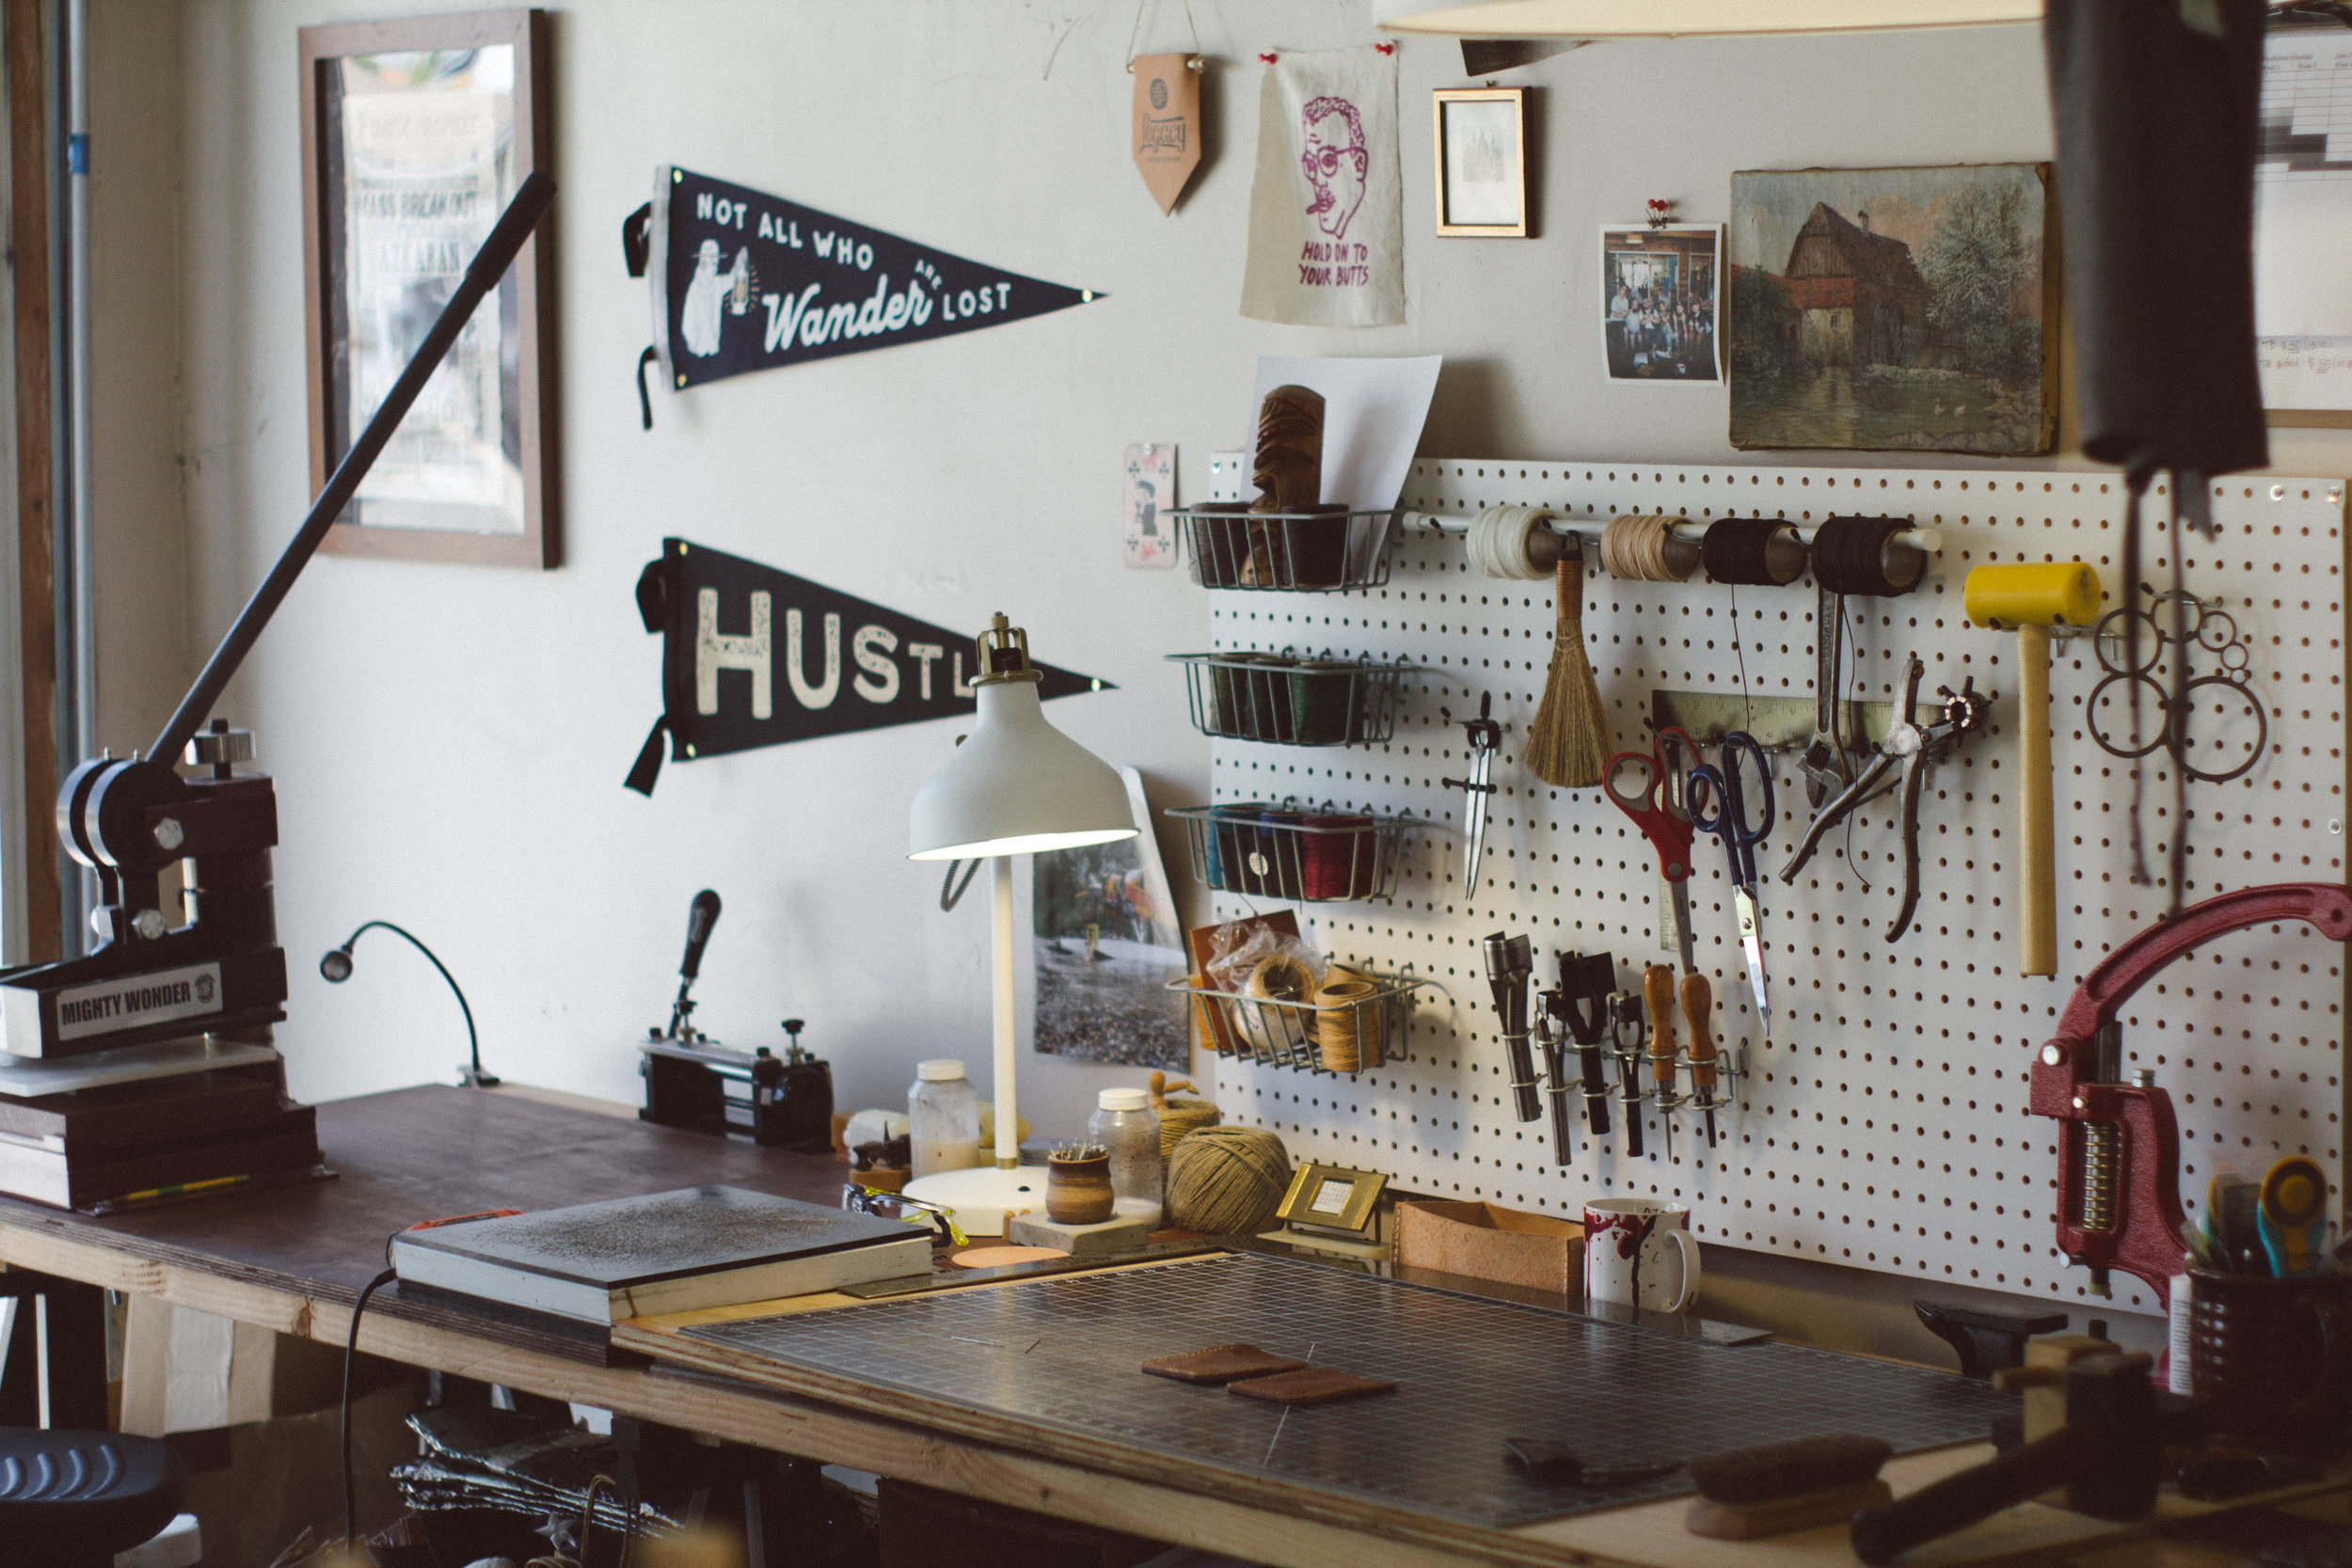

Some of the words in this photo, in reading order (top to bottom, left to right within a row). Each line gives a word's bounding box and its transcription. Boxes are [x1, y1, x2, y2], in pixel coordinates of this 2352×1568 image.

[697, 194, 746, 230] NOT
[758, 213, 803, 248] ALL
[813, 230, 873, 270] WHO
[1301, 242, 1331, 261] HOLD
[1335, 244, 1348, 261] ON
[1353, 244, 1368, 261] TO
[914, 260, 942, 289] ARE
[1298, 263, 1331, 286] YOUR
[1336, 266, 1369, 286] BUTTS
[762, 275, 933, 353] Wander
[943, 283, 1011, 321] LOST
[696, 588, 977, 720] HUSTL
[61, 994, 122, 1026] MIGHTY
[124, 981, 191, 1013] WONDER
